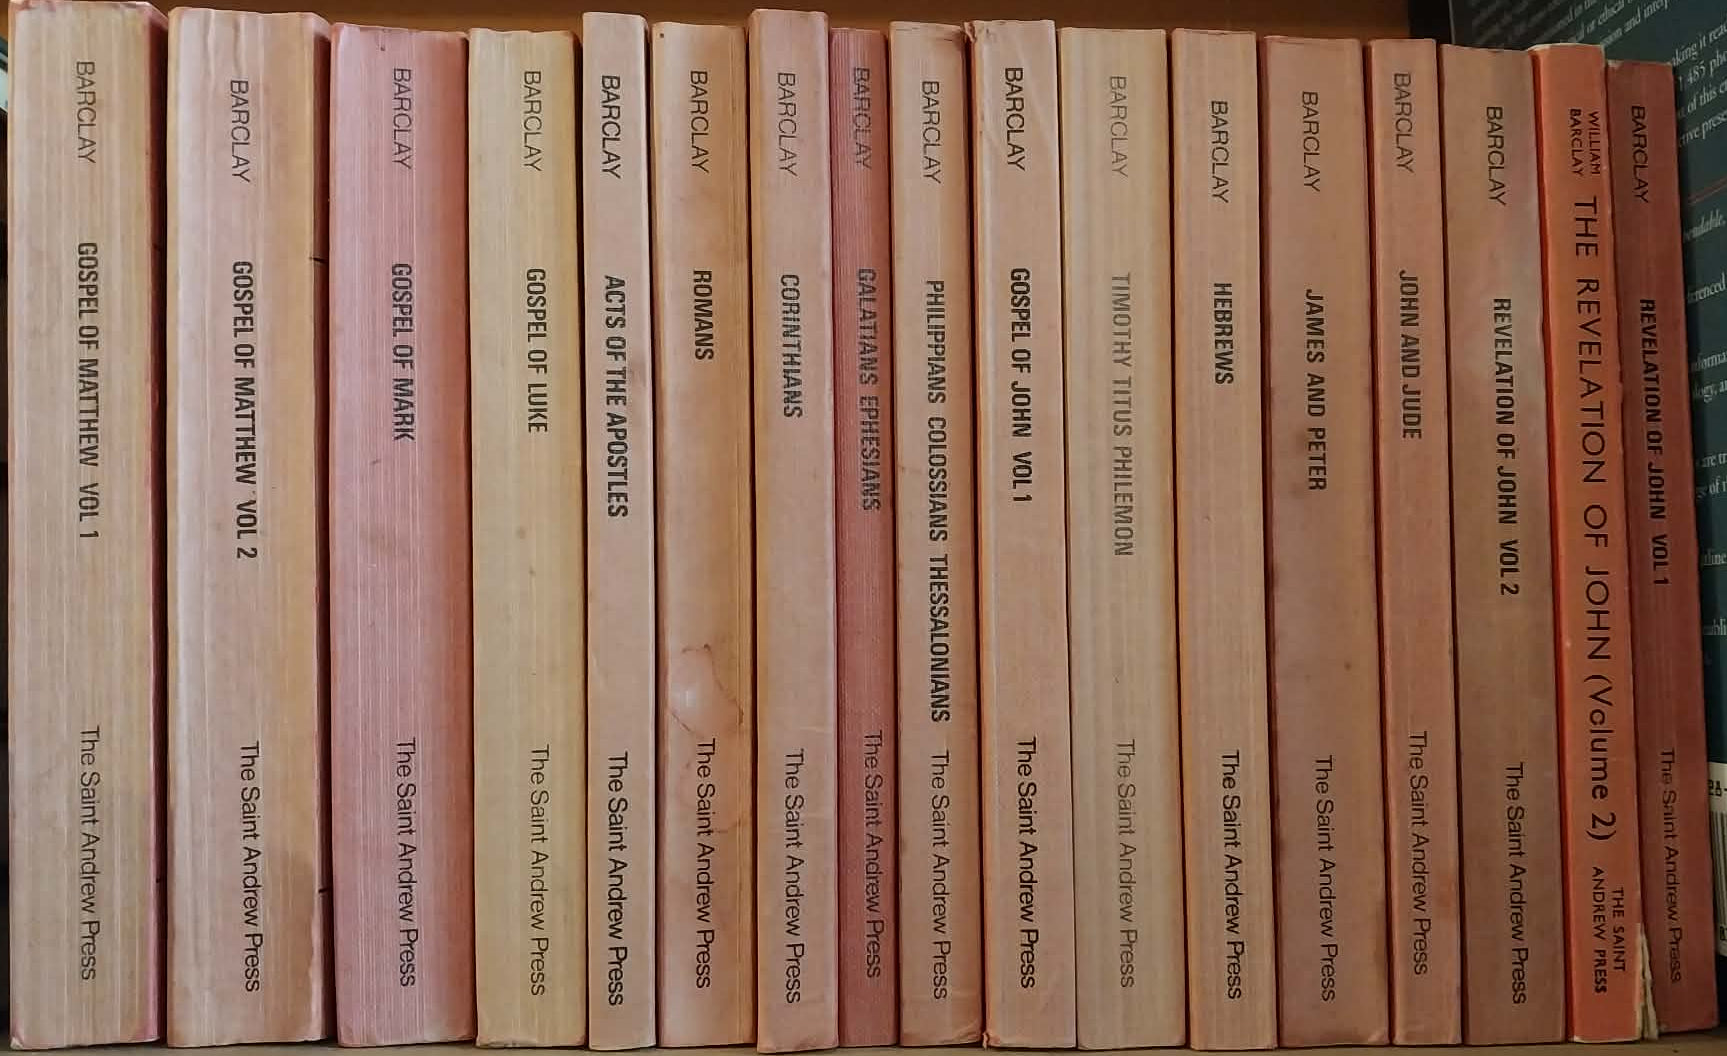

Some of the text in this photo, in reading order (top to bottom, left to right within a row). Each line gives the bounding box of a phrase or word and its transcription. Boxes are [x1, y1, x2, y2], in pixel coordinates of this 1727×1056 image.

[1624, 6, 1642, 33] and
[76, 61, 96, 163] BARCLAY
[230, 80, 250, 182] BARCLAY
[393, 68, 413, 170] BARCLAY
[524, 71, 542, 171] BARCLAY
[602, 75, 621, 178] BARCLAY
[691, 71, 709, 173] BARCLAY
[778, 73, 797, 176] BARCLAY
[852, 67, 871, 168] BARCLAY
[922, 81, 941, 183] BARCLAY
[1005, 68, 1025, 171] BARCLAY
[1110, 76, 1128, 177] BARCLAY
[1302, 91, 1320, 191] BARCLAY
[1394, 73, 1413, 173] BARCLAY
[1570, 109, 1584, 176] BARCLAY
[1588, 111, 1601, 174] WILLIAM
[1699, 83, 1718, 107] this
[1211, 101, 1229, 203] BARCLAY
[1487, 107, 1506, 205] BARCLAY
[1631, 106, 1648, 203] BARCLAY
[78, 243, 98, 320] GOSPEL
[693, 271, 714, 360] ROMANS
[1011, 268, 1031, 342] GOSPEL
[79, 326, 99, 350] OF
[392, 264, 415, 440] GOSPEL OF MARK
[527, 269, 547, 433] GOSPEL OF LUKE
[781, 275, 802, 418] CORINTHIANS
[1012, 349, 1031, 373] OF
[1214, 283, 1234, 384] HEBREWS
[1399, 270, 1421, 439] JOHN AND JUDE
[1640, 299, 1662, 422] REVELATION
[78, 359, 99, 466] MATTHEW
[233, 261, 257, 558] GOSPEL OF MATTHEW VOL 2
[605, 276, 628, 517] ACTS OF THE APOSTLES
[857, 269, 880, 510] GALATIANS EPHESIANS
[1011, 381, 1031, 437] JOHN
[1112, 273, 1133, 555] TIMOTHY TITUS PHILEMON
[1306, 289, 1327, 490] JAMES AND PETER
[1013, 452, 1032, 489] VOL
[1494, 299, 1519, 595] REVELATION OF JOHN VOL 2
[1647, 430, 1663, 454] OF
[1648, 462, 1665, 519] JOHN
[79, 483, 99, 522] VOL
[926, 281, 950, 722] PHILIPPIANS COLOSSIANS THESSALONIANS
[1574, 195, 1616, 840] THE REVELATION OF JOHN (Volume 2)
[1652, 534, 1668, 571] VOL
[80, 725, 100, 980] The Saint Andrew Press
[241, 741, 263, 992] The Saint Andrew Press
[397, 737, 418, 986] The Saint Andrew Press
[531, 744, 549, 995] The Saint Andrew Press
[608, 751, 628, 1006] The Saint Andrew Press
[696, 738, 715, 988] The Saint Andrew Press
[785, 749, 804, 1003] The Saint Andrew Press
[864, 730, 884, 978] The Saint Andrew Press
[932, 750, 951, 999] The Saint Andrew Press
[1018, 736, 1039, 988] The Saint Andrew Press
[1117, 739, 1137, 987] The Saint Andrew Press
[1222, 750, 1245, 999] The Saint Andrew Press
[1316, 755, 1338, 1001] The Saint Andrew Press
[1409, 731, 1431, 975] The Saint Andrew Press
[1506, 762, 1528, 1004] The Saint Andrew Press
[1661, 748, 1682, 983] The Saint Andrew Press
[1592, 867, 1607, 993] ANDREW PRESS
[1611, 887, 1626, 971] THE SAINT
